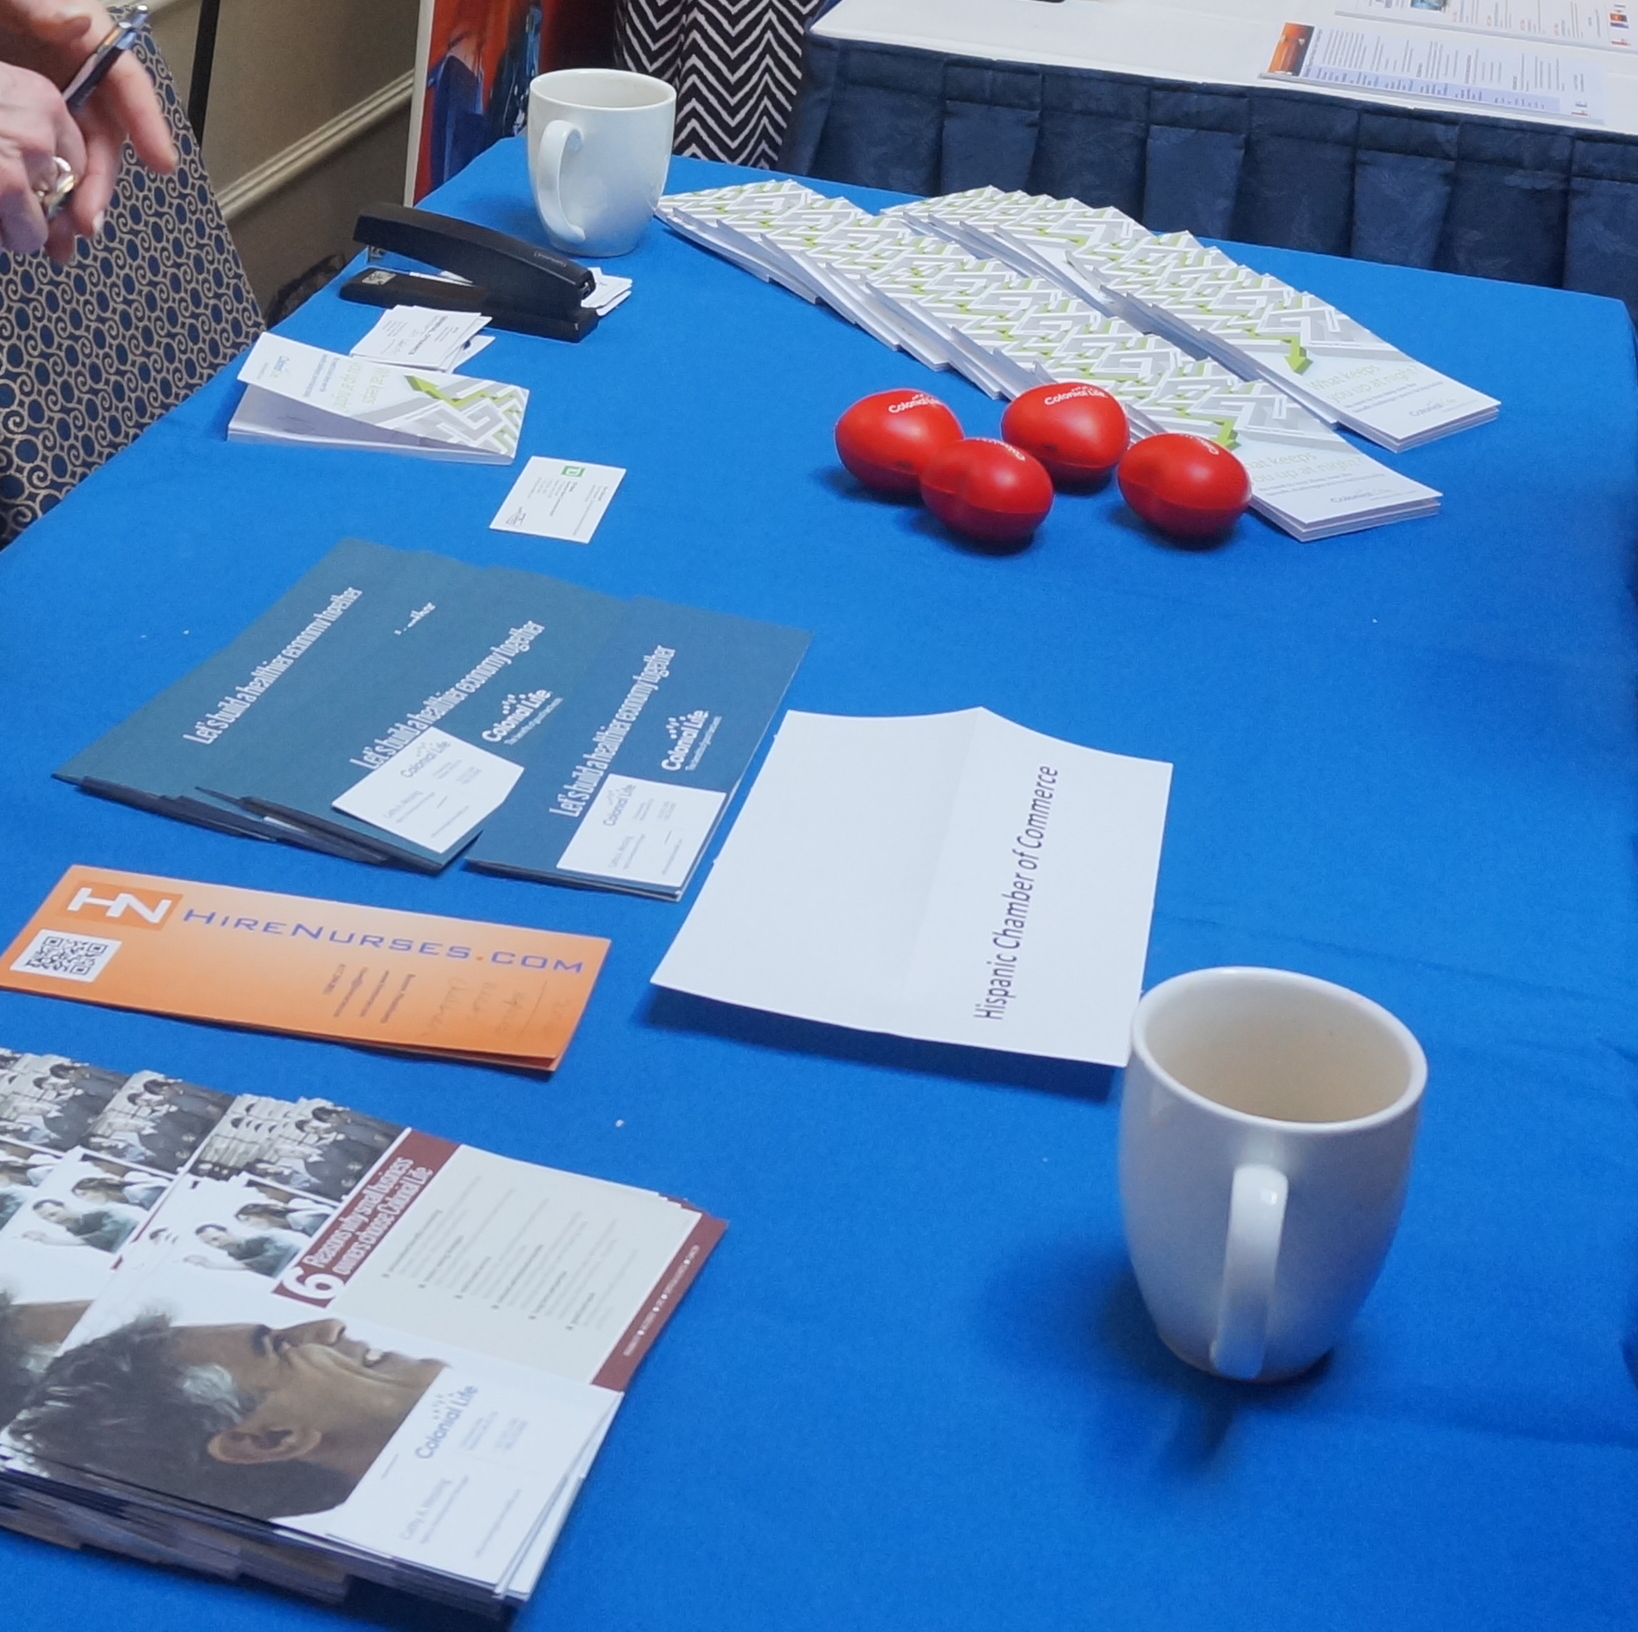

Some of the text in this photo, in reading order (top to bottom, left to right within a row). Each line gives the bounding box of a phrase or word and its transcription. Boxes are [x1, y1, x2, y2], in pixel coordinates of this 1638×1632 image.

[1044, 388, 1088, 407] Colonial
[1247, 450, 1318, 471] hat keeps
[481, 700, 534, 743] Colonial
[527, 688, 552, 711] Life
[661, 723, 700, 771] Colonial
[686, 708, 710, 730] Life
[67, 886, 173, 925] HN
[972, 764, 1060, 1021] Hispanic Chamber of Commerce
[301, 1229, 353, 1269] Reasons
[366, 1156, 415, 1196] business
[281, 1266, 347, 1300] 6
[414, 1405, 462, 1460] Colonial
[454, 1384, 479, 1408] Life
